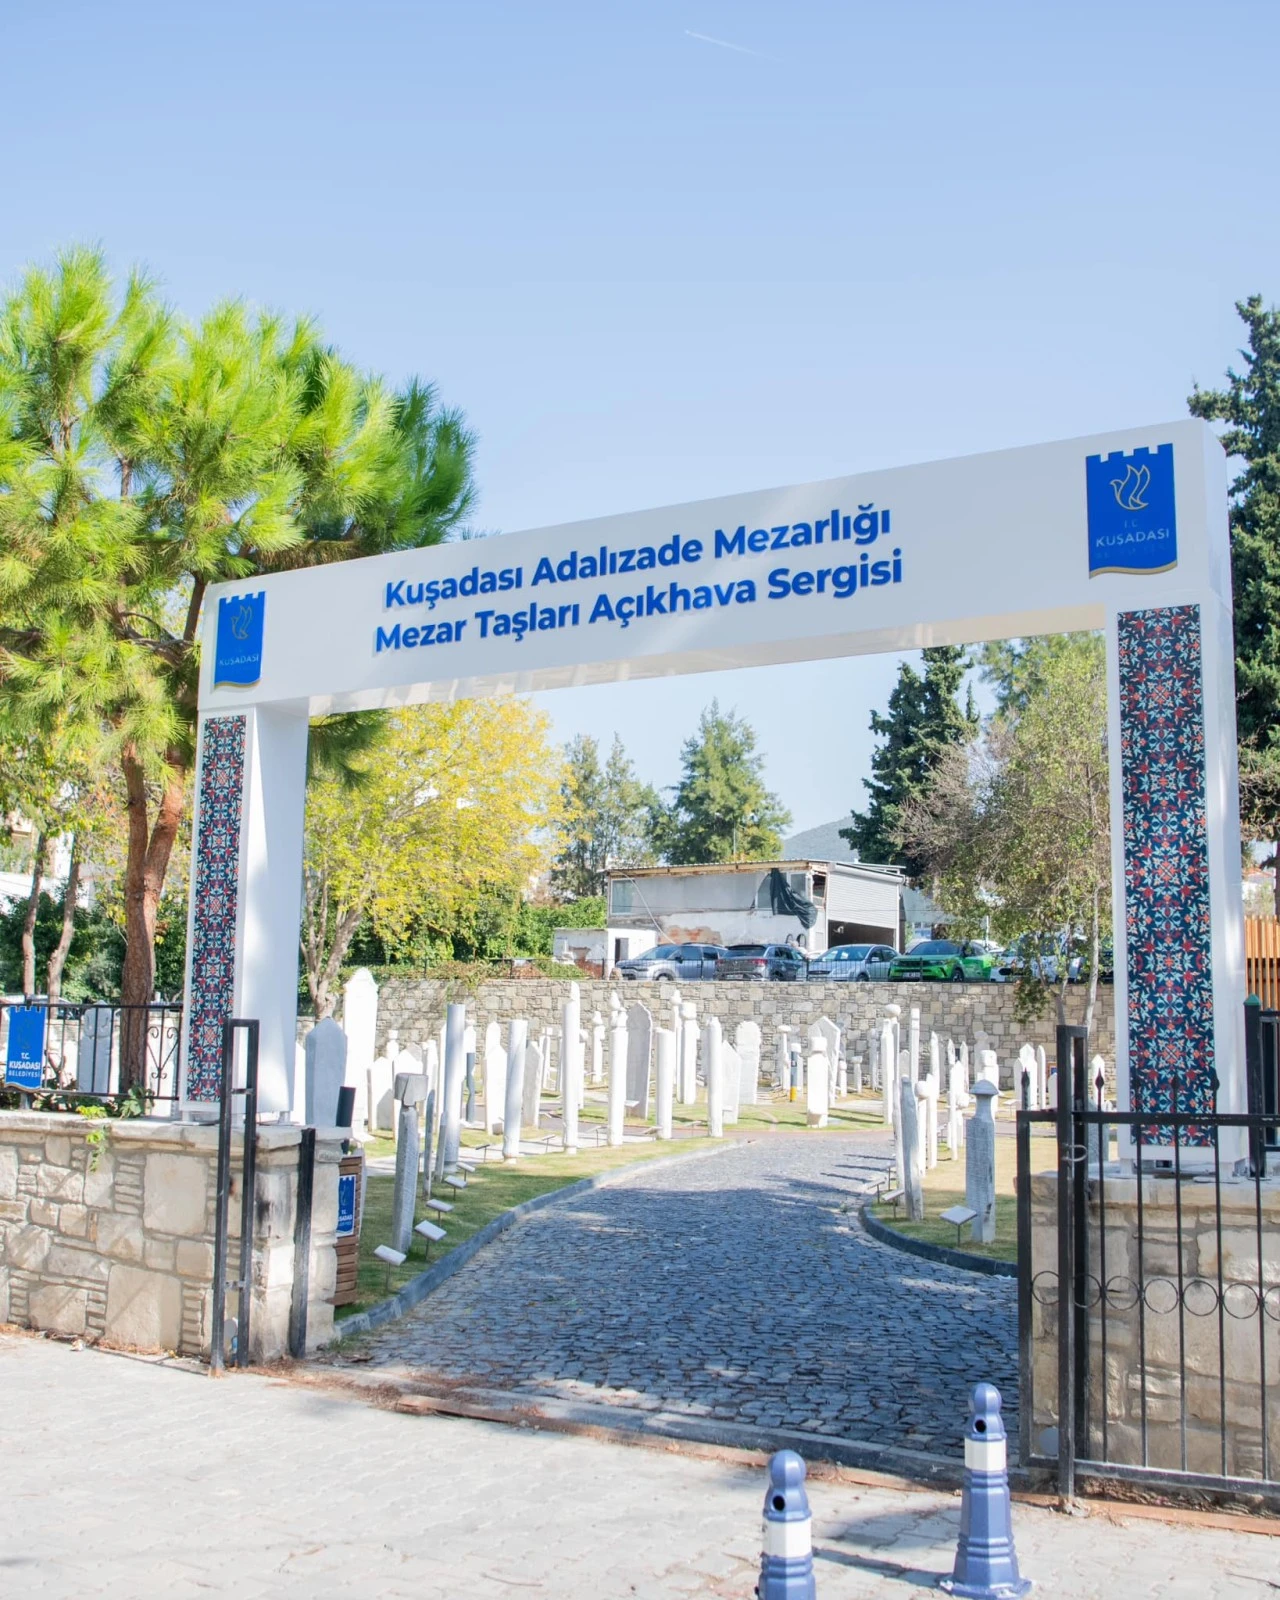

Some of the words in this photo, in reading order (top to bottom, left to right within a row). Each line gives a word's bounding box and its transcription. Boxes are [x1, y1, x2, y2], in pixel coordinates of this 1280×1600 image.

[376, 619, 468, 653] Mezar
[475, 602, 580, 642] Taşları
[588, 579, 757, 629] Açıkhava
[767, 547, 902, 600] Sergisi
[386, 567, 523, 610] Kuşadası
[531, 535, 704, 586] Adalızade
[714, 503, 891, 559] Mezarlığı
